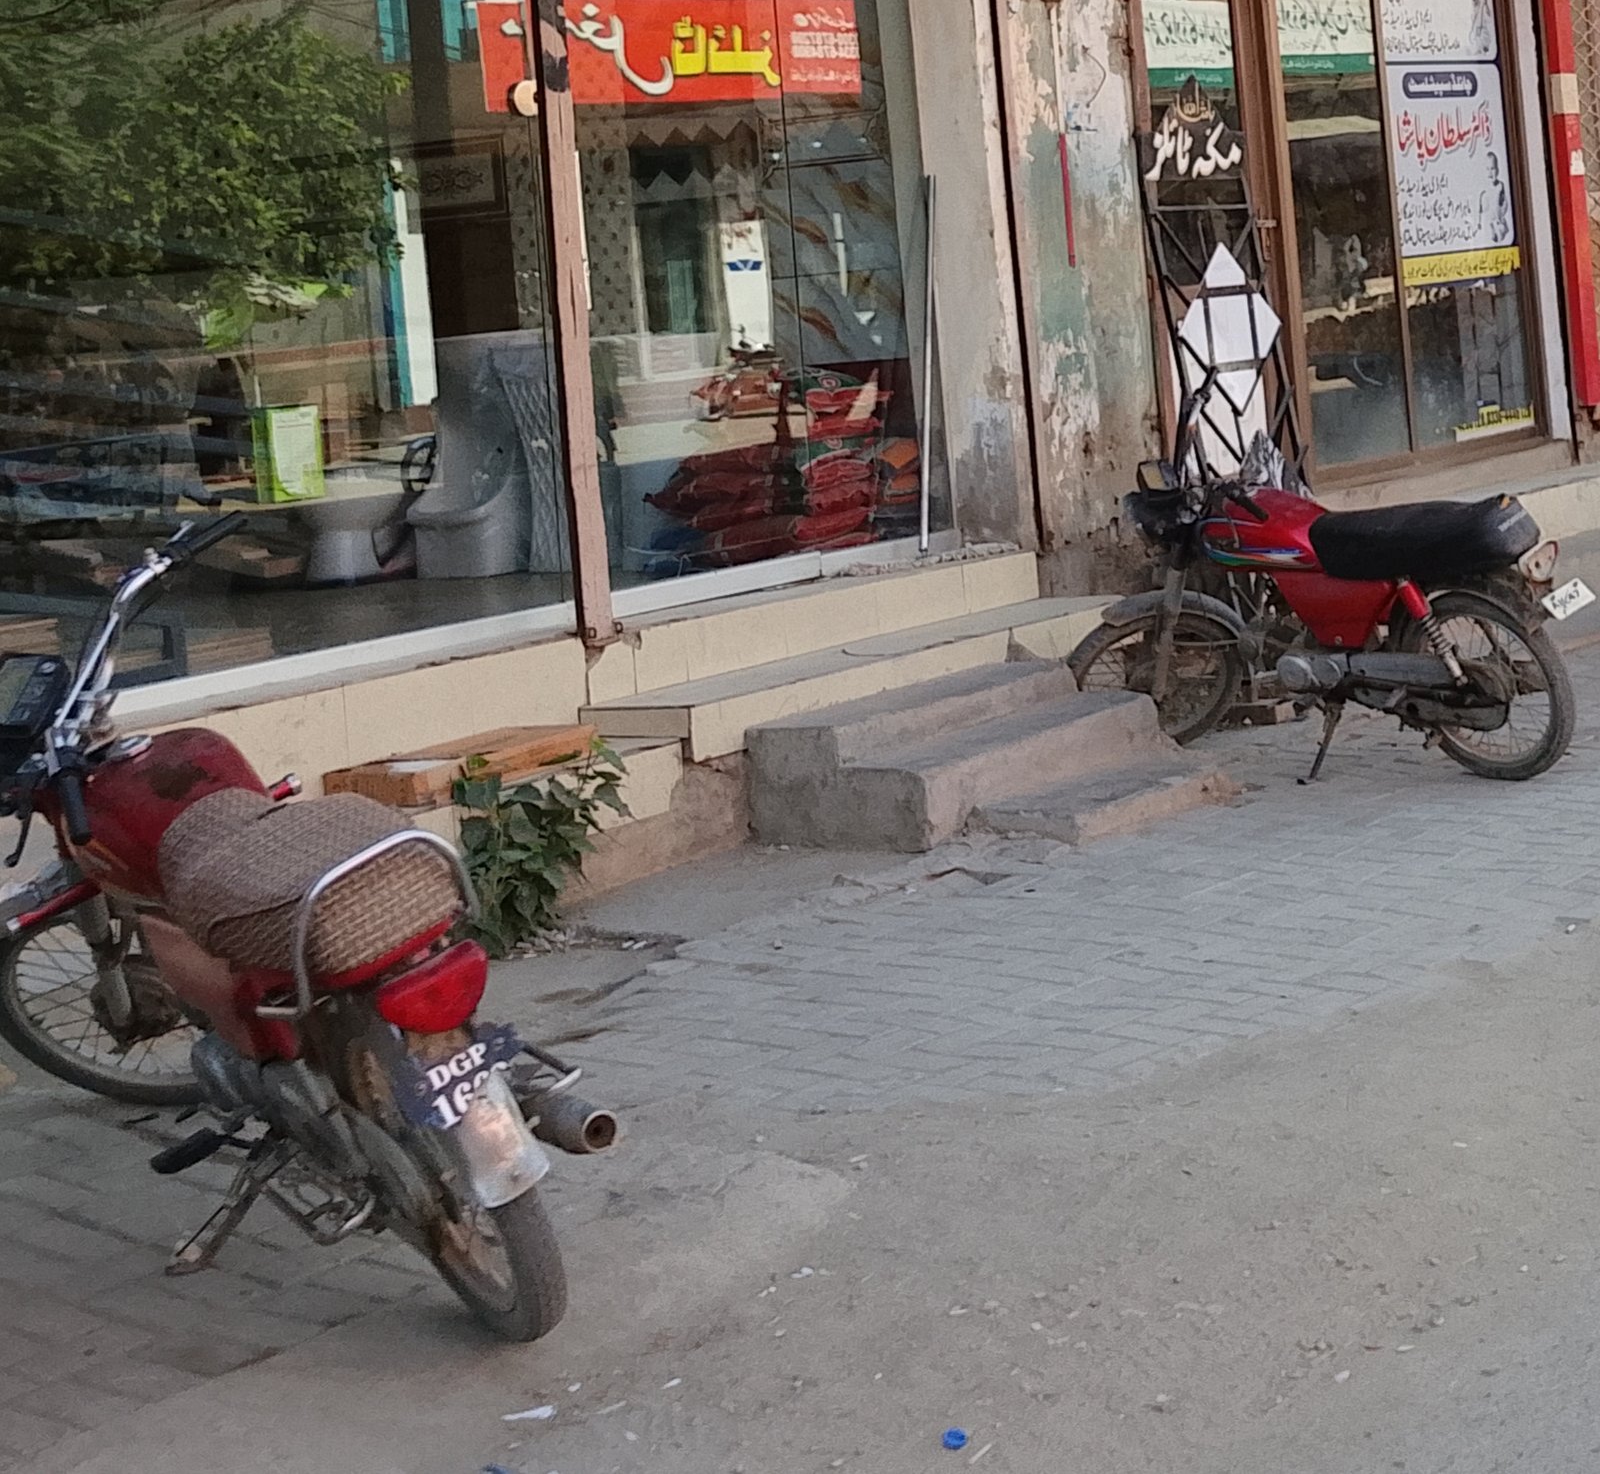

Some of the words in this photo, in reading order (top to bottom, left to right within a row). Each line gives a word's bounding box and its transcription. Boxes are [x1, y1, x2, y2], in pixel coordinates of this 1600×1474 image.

[1396, 109, 1425, 166] پاشا
[1425, 106, 1472, 157] سلطان
[1469, 100, 1491, 154] ڈاکٹر
[425, 1042, 487, 1091] DGP
